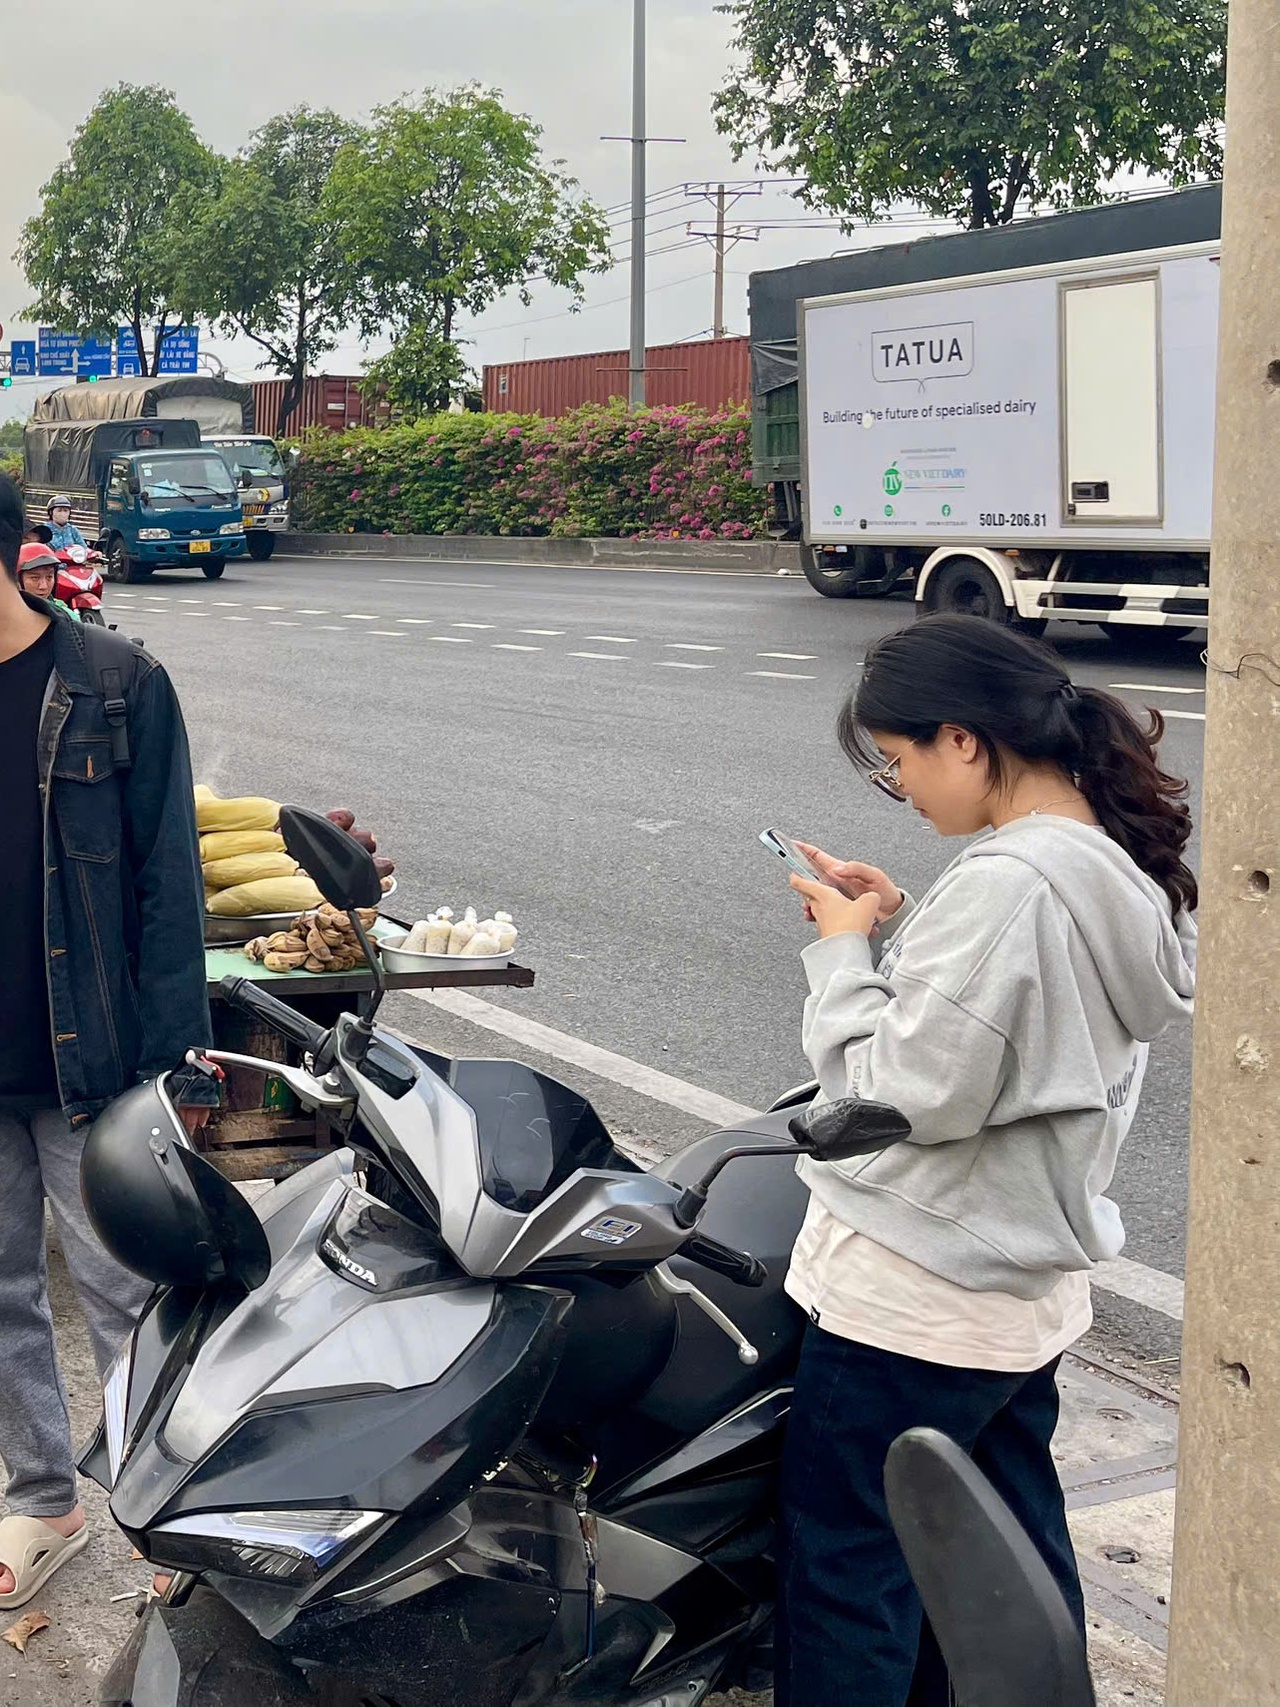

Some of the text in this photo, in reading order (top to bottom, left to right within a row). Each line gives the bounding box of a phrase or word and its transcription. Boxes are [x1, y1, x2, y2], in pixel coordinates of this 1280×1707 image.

[880, 338, 964, 368] TATUA
[822, 409, 863, 425] Building
[885, 406, 919, 420] future
[921, 405, 933, 418] of
[935, 401, 1001, 419] specialised
[1003, 399, 1036, 415] dairy
[979, 512, 1047, 527] 50LD-206.81
[322, 1238, 378, 1287] HONDA
